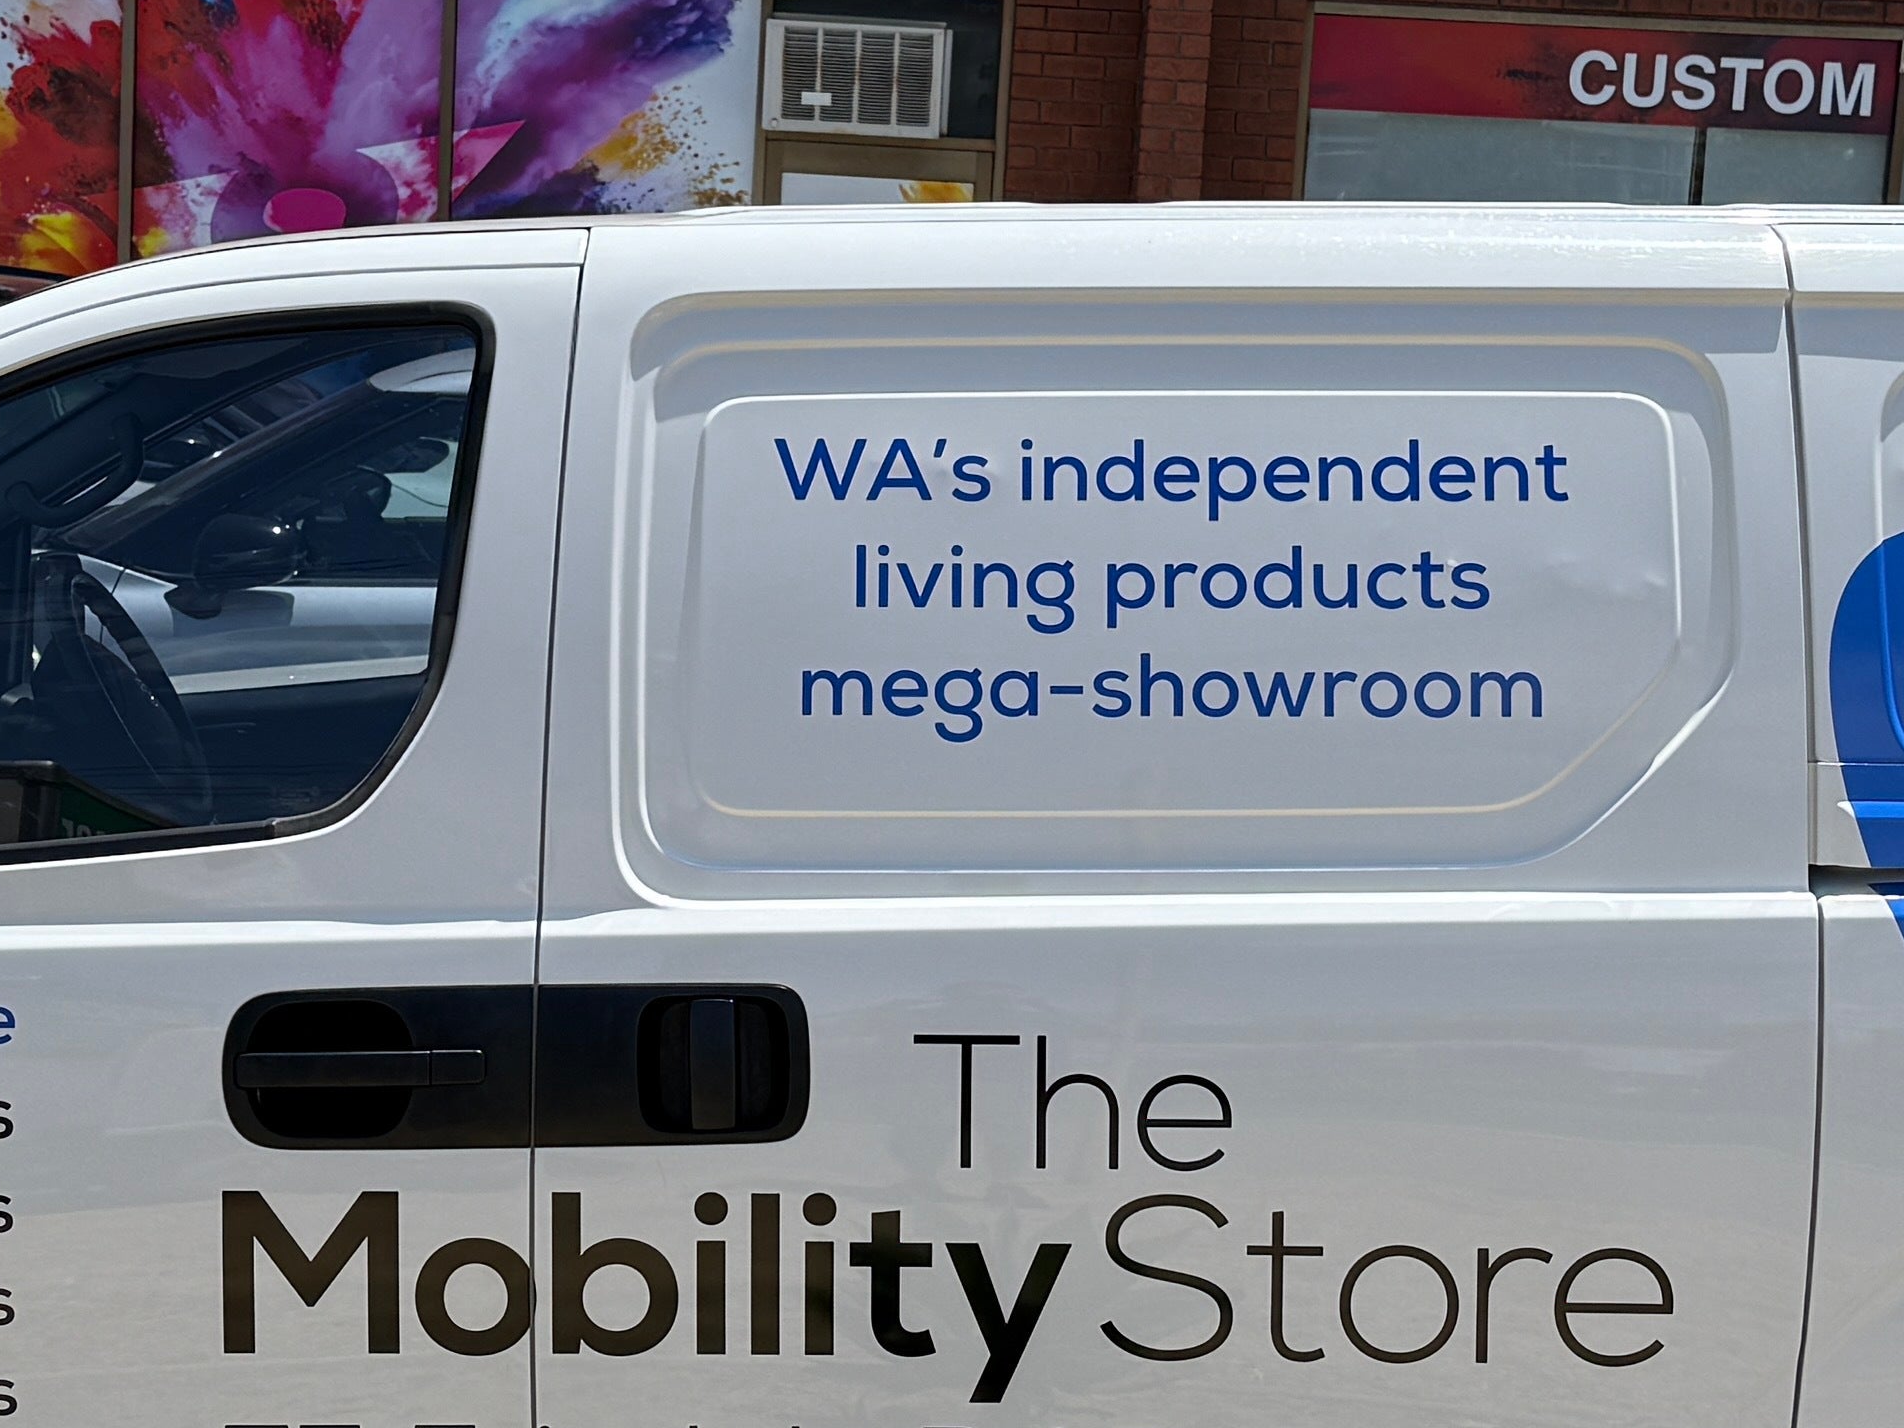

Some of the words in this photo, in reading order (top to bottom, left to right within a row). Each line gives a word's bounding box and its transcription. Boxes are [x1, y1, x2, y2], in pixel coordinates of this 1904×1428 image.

[1570, 50, 1875, 116] CUSTOM
[774, 439, 990, 501] WA's
[1022, 439, 1568, 521] independent
[856, 545, 1074, 634] living
[1107, 546, 1489, 628] products
[802, 653, 1542, 742] mega-showroom
[914, 1035, 1232, 1171] The
